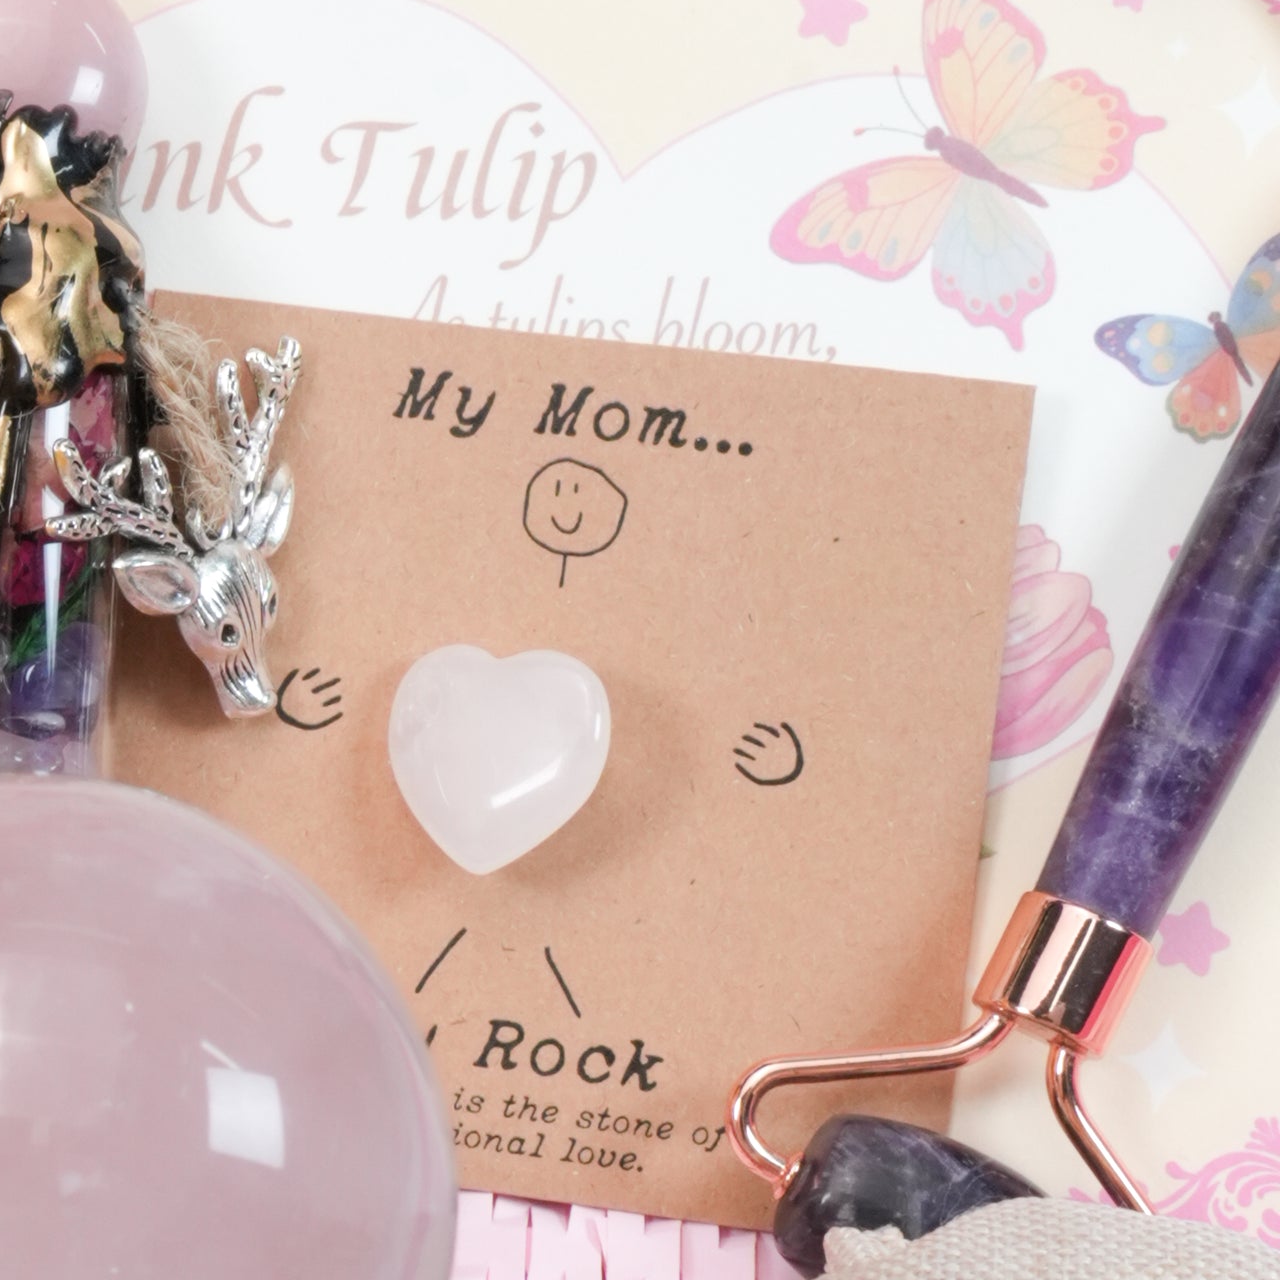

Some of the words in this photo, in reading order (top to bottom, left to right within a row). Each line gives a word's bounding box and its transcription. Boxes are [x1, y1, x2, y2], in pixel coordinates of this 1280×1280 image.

[117, 85, 294, 229] ink
[320, 101, 599, 271] Tulip
[652, 275, 838, 361] bloom,
[392, 366, 497, 438] My
[533, 382, 754, 457] Mom...
[472, 1018, 665, 1093] Rock
[452, 1086, 485, 1114] is
[502, 1094, 560, 1125] the
[575, 1107, 675, 1141] stone
[691, 1124, 726, 1153] of
[452, 1122, 546, 1159] ional
[560, 1138, 645, 1174] love.
